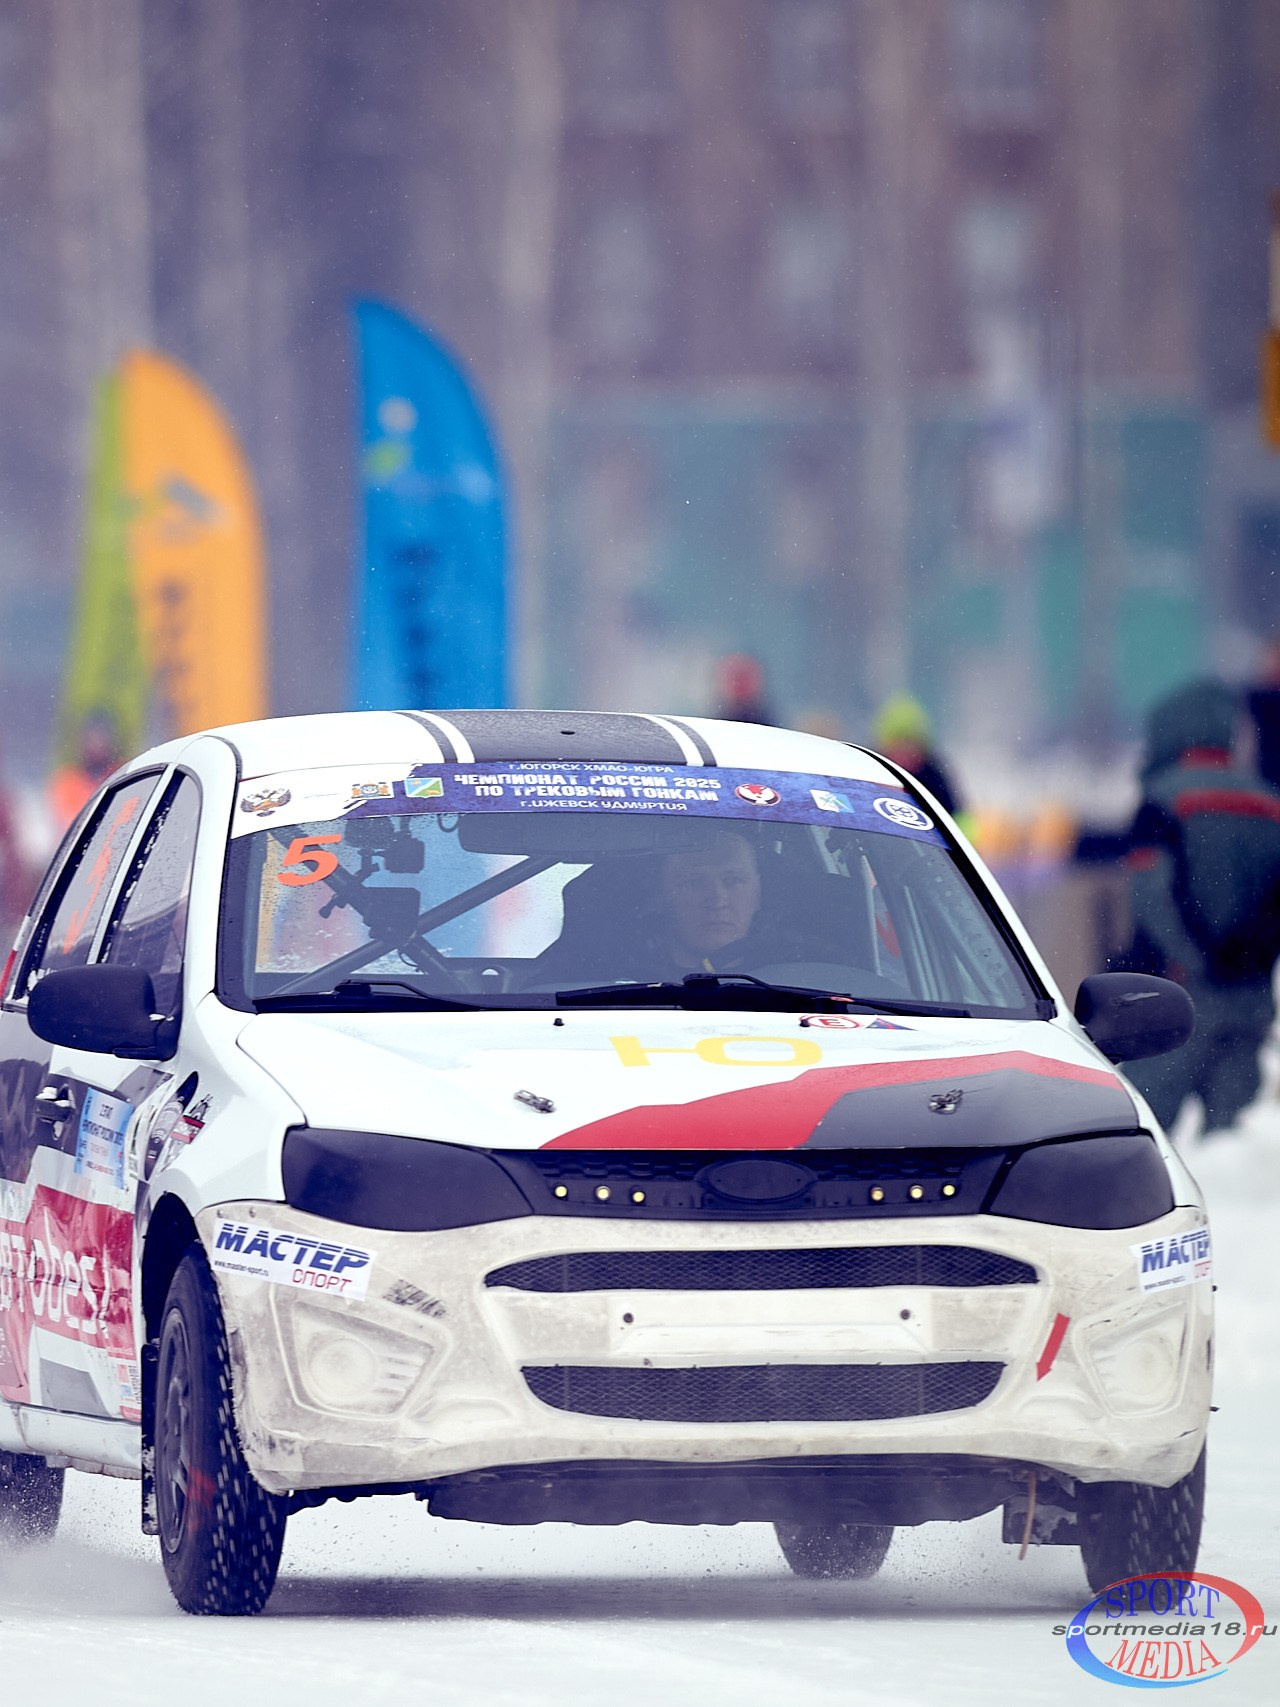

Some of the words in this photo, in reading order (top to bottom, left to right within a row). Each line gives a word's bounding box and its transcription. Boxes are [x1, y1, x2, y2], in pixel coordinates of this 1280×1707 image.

[454, 774, 578, 785] ЧЕМПИОНАТ
[590, 774, 667, 787] РОССИИ
[673, 777, 721, 789] 2025
[475, 785, 504, 796] ПО
[514, 785, 626, 798] ТРЕКОВЫМ
[632, 788, 719, 801] ГОНКАМ
[278, 834, 342, 886] 5
[609, 1035, 823, 1067] Ю
[215, 1223, 370, 1274] МАСТЕР
[292, 1268, 352, 1292] СПОРТ
